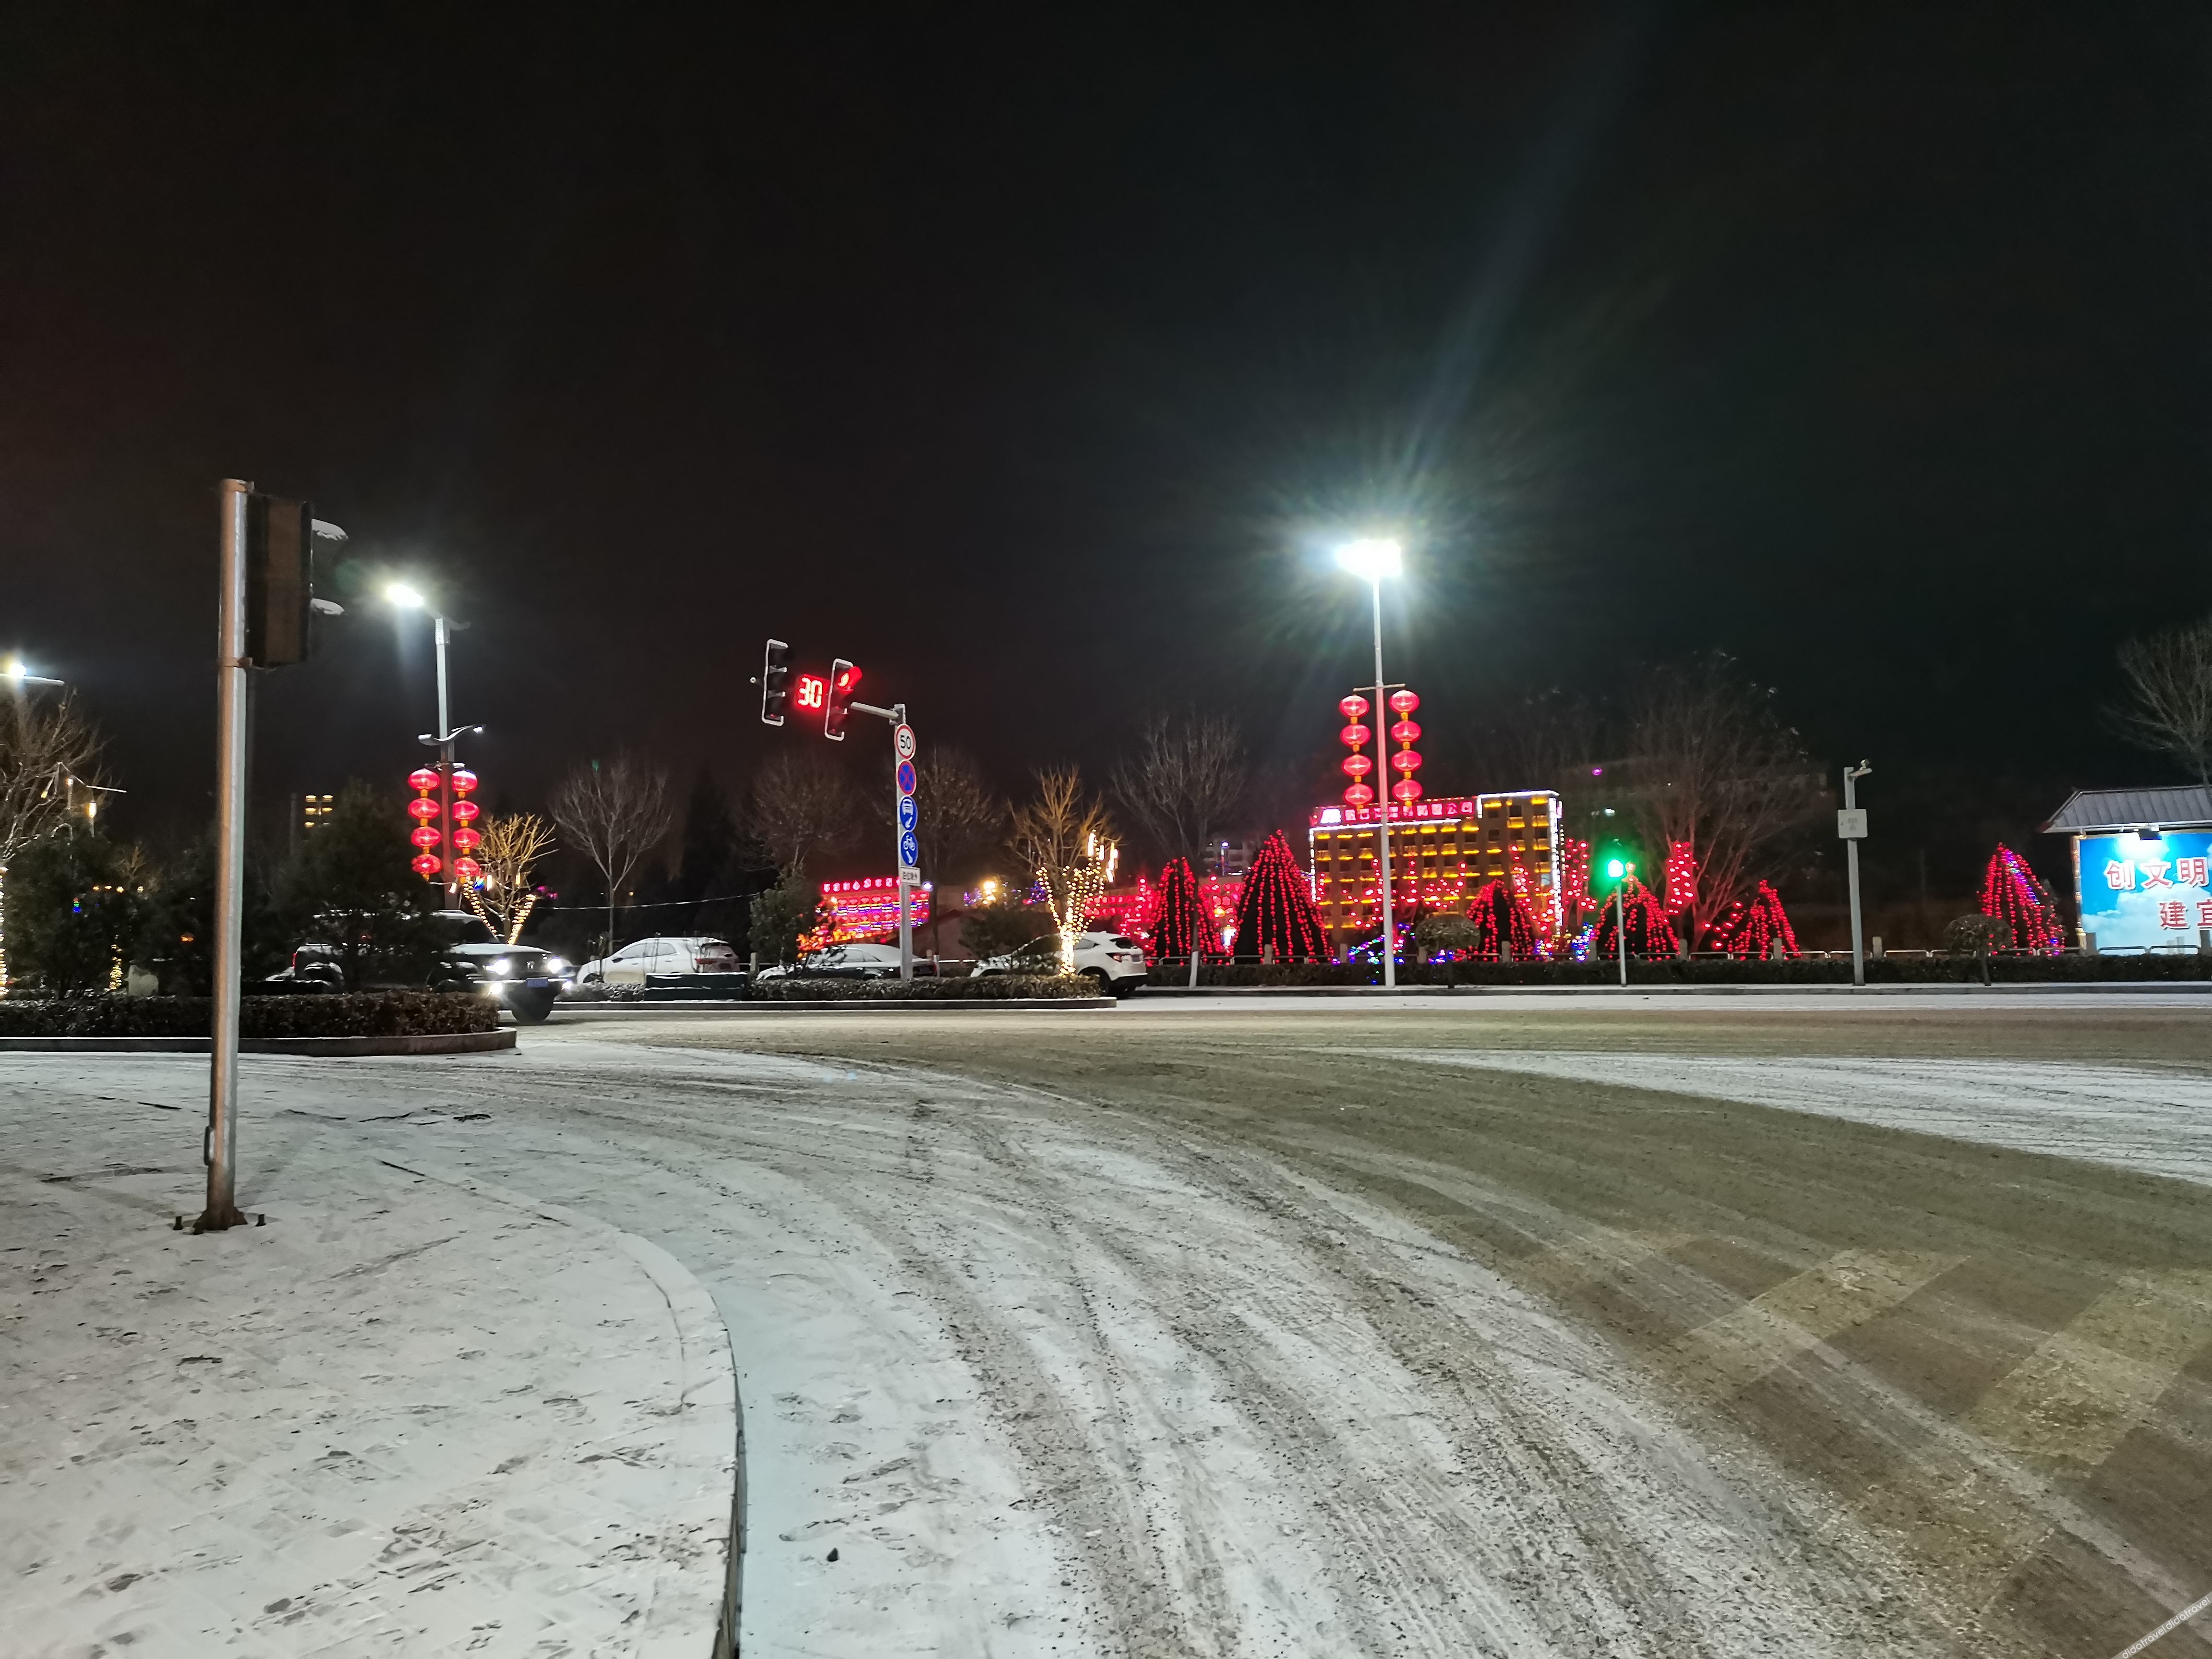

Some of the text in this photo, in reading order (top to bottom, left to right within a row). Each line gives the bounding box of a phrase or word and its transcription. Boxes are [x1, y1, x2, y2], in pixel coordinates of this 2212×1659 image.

[798, 677, 823, 708] 30
[900, 734, 911, 750] 50
[2105, 857, 2209, 889] 创文明
